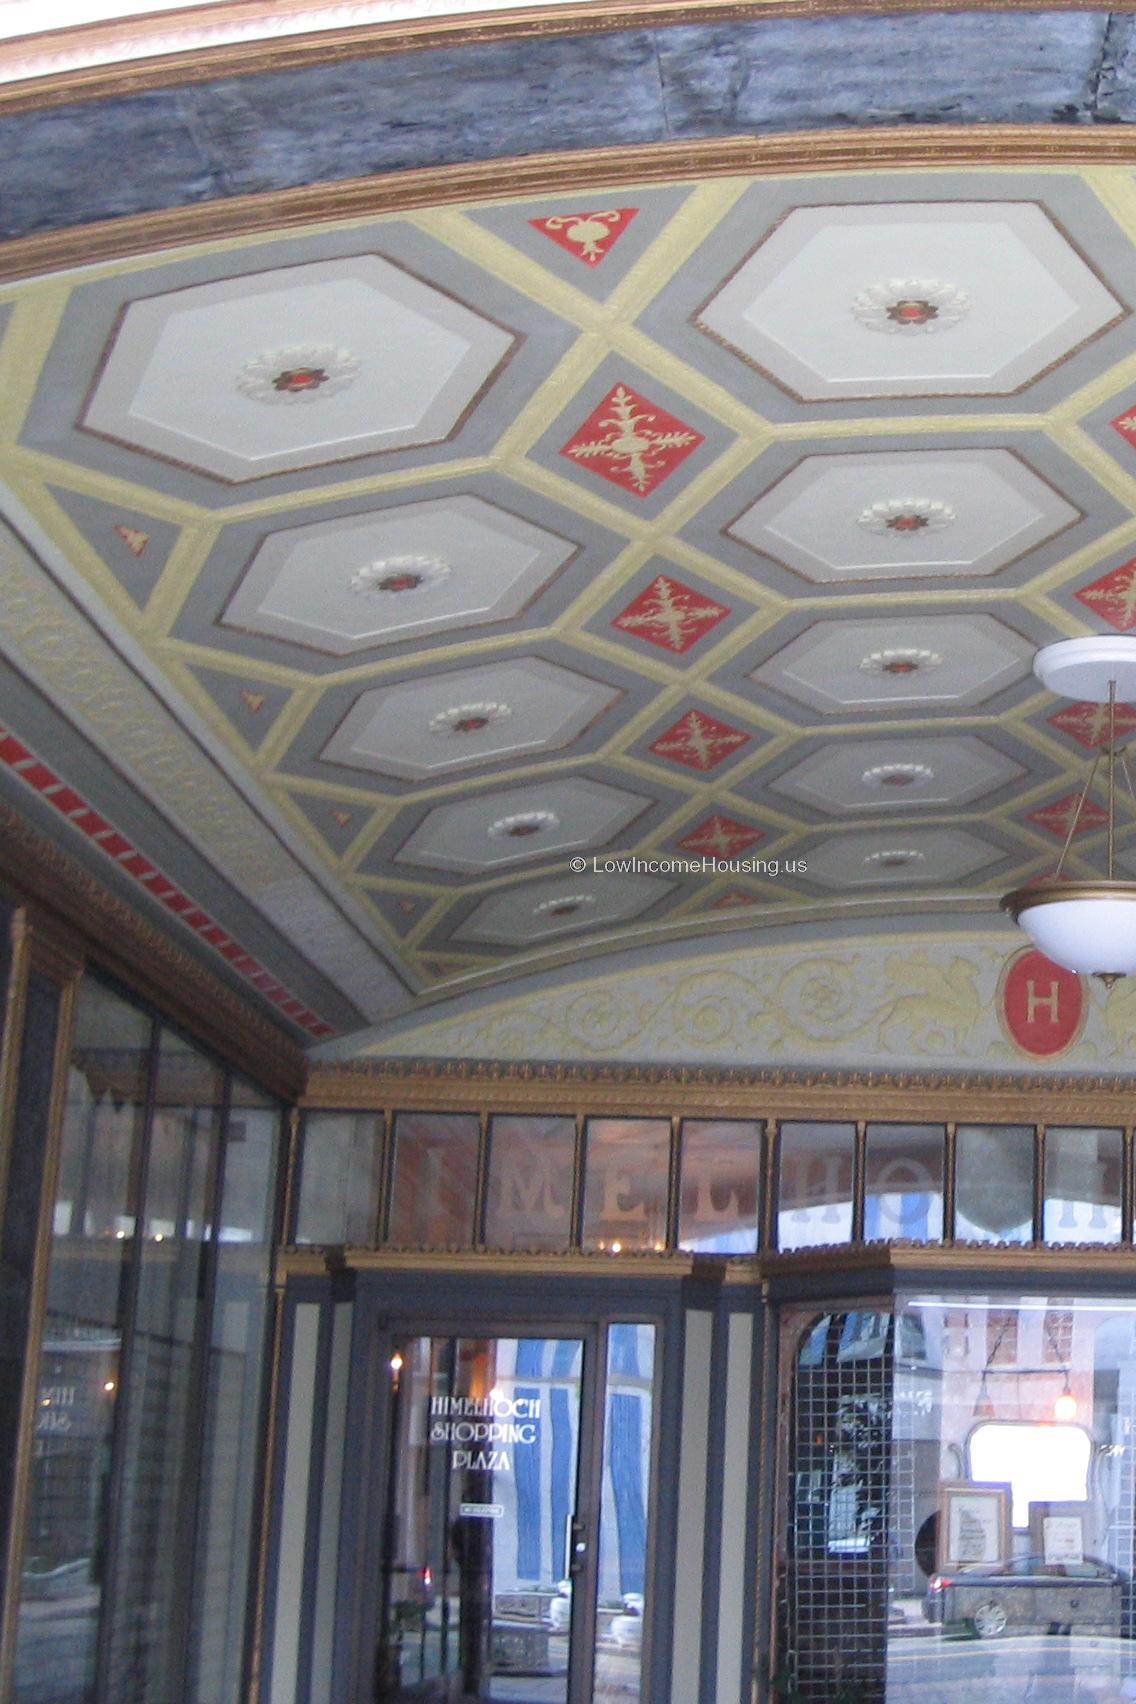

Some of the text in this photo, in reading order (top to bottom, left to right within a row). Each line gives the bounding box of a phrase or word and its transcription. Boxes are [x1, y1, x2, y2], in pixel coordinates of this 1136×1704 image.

[1025, 979, 1060, 1025] H
[432, 1397, 540, 1418] HIMELHOCH
[431, 1422, 536, 1443] SHOPPING
[452, 1450, 510, 1469] PLAZA
